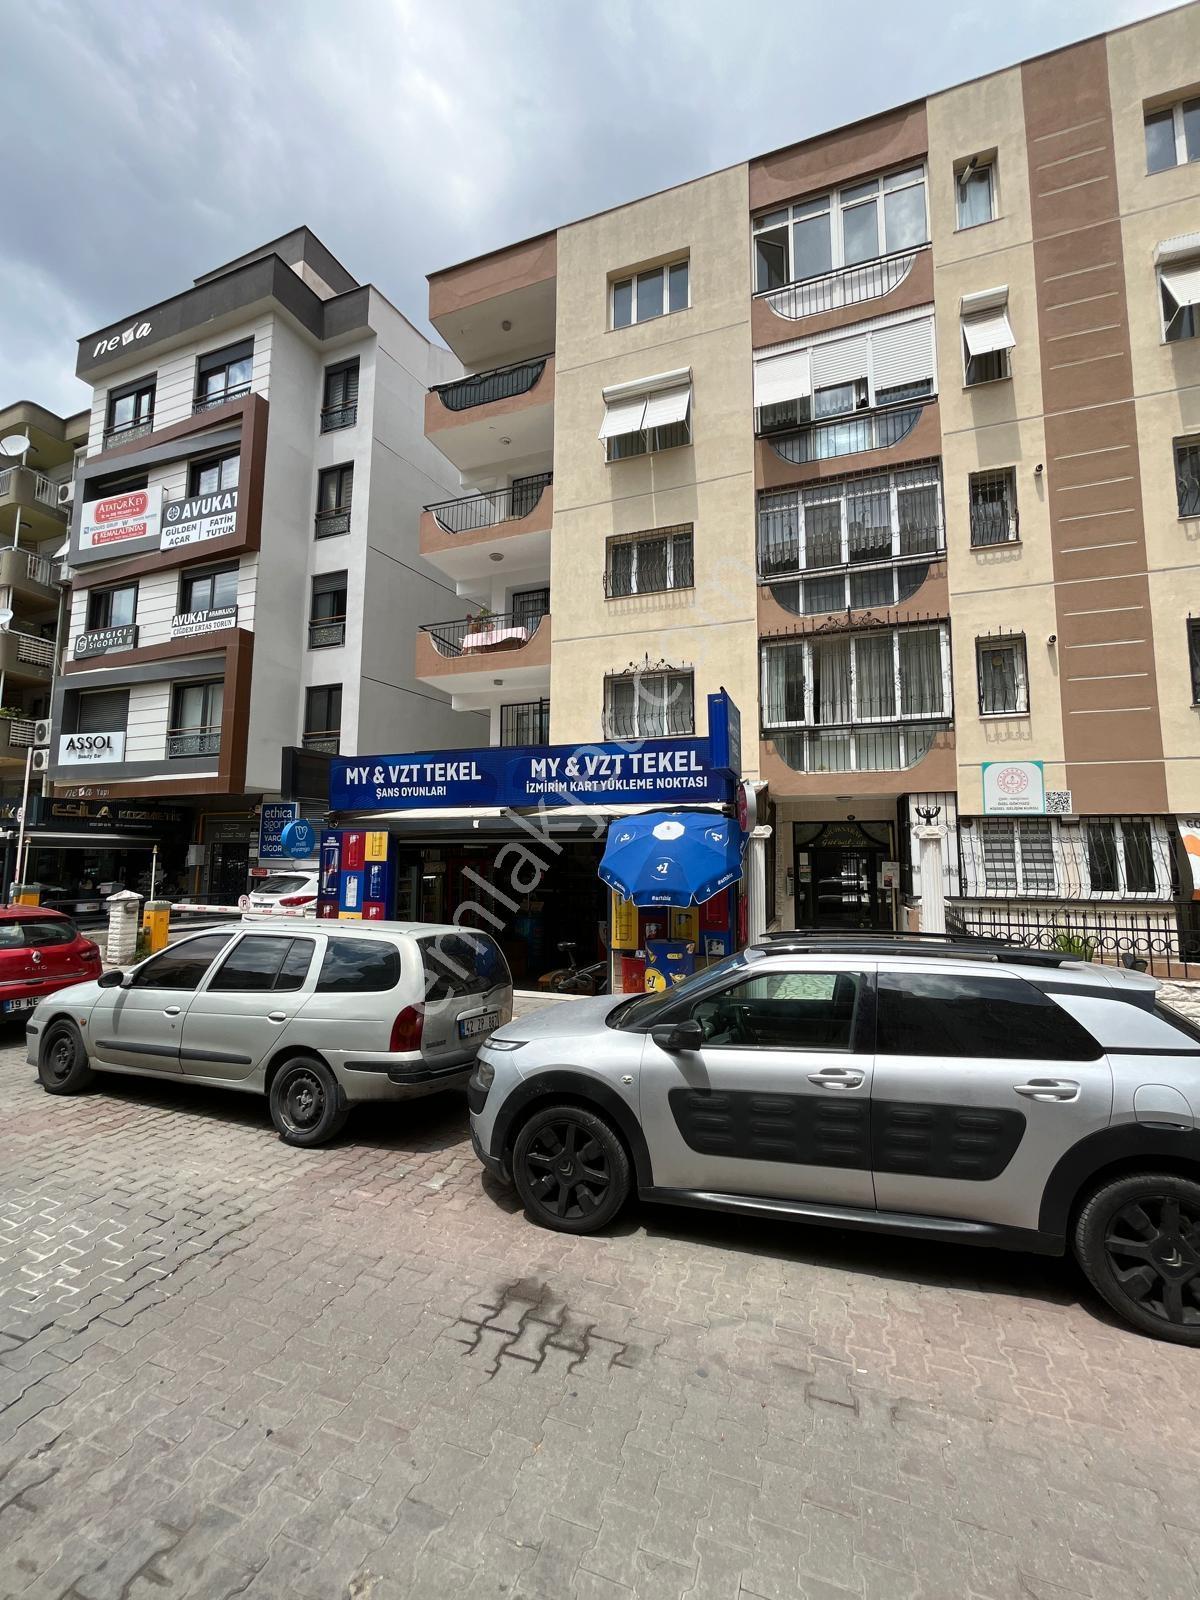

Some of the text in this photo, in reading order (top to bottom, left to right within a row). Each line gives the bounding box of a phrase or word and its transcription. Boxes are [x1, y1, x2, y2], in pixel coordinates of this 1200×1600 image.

[181, 491, 238, 519] AVUKAT
[209, 515, 233, 527] FATİH
[165, 523, 197, 537] GÜLDEN
[206, 524, 234, 537] TUTUK
[169, 534, 191, 546] AÇAR
[172, 610, 209, 627] AVUKAT
[65, 735, 113, 750] ASSOL
[531, 750, 703, 778] MY & VZT TEKEL
[346, 761, 482, 785] MY & VZT TEKEL
[526, 776, 707, 793] İZMİRİM KART YÜKLEME NOKTASI
[376, 786, 447, 799] ŞANS OYUNLARI
[264, 806, 292, 818] ethica
[656, 862, 669, 874] +1
